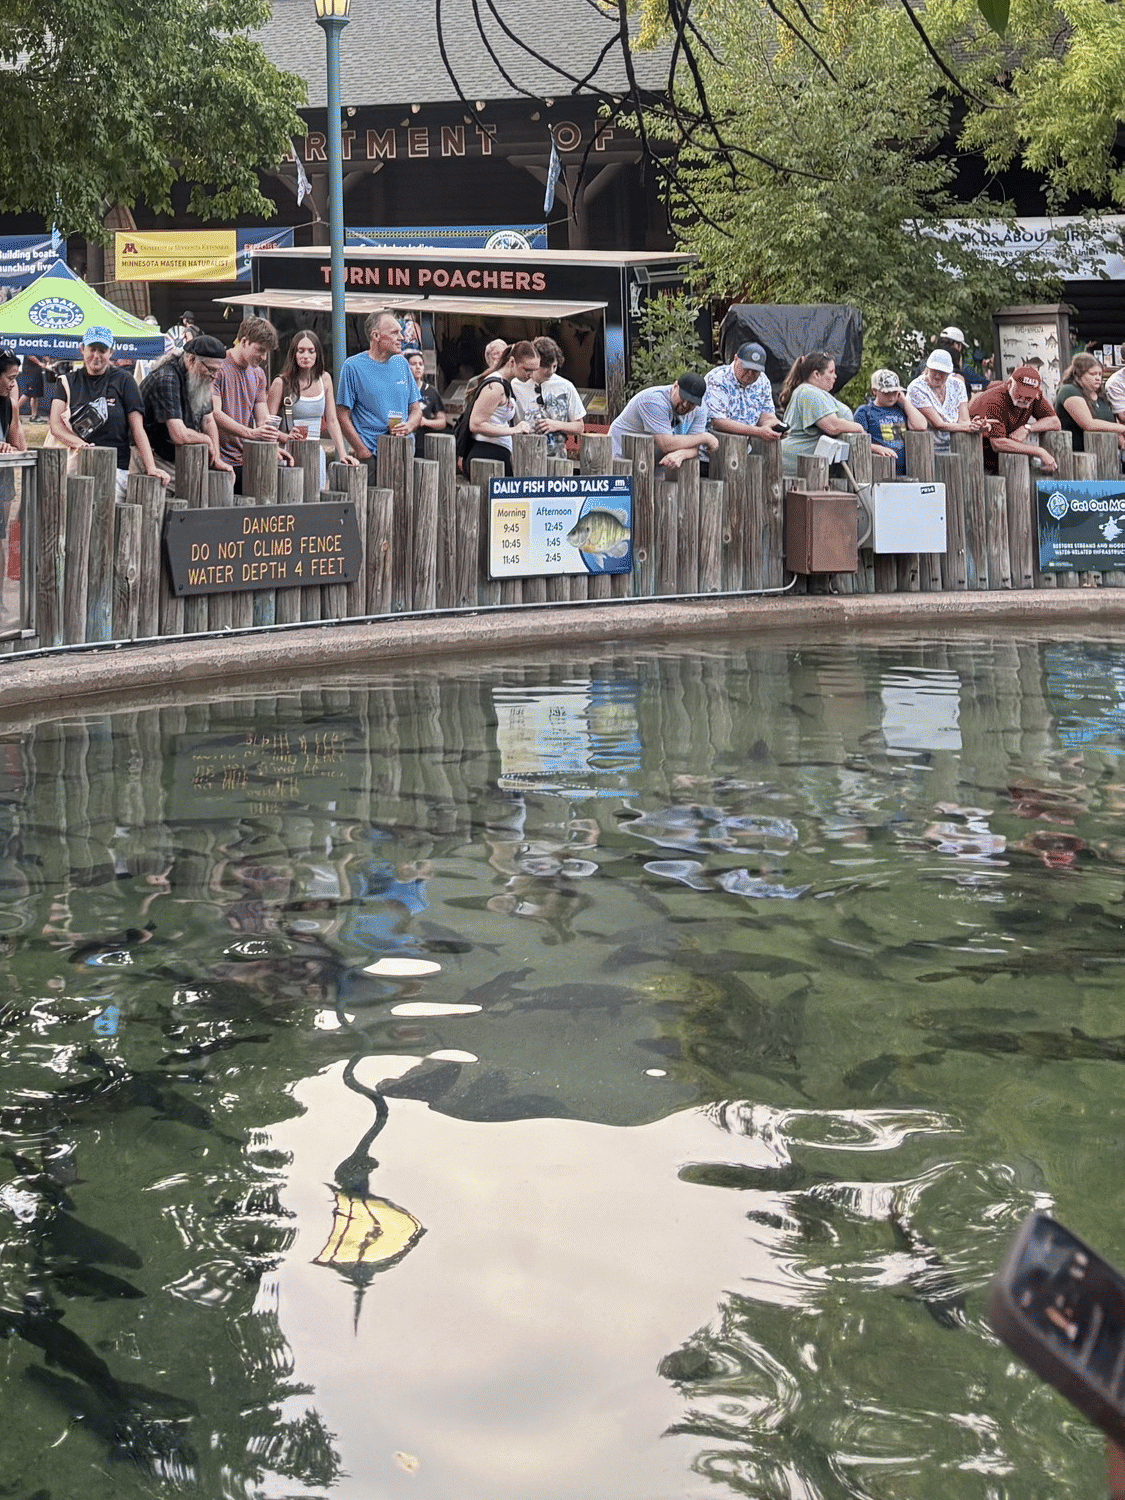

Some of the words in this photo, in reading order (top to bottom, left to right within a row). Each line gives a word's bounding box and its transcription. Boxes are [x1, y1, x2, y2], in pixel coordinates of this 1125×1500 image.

[282, 124, 497, 162] RTMENT
[551, 119, 617, 152] OF
[981, 232, 999, 243] US
[1003, 231, 1048, 243] ABOU
[32, 249, 59, 258] boats.
[37, 262, 53, 271] live
[321, 266, 380, 285] TRN
[387, 267, 410, 286] IN
[418, 269, 547, 291] POACHERS
[37, 298, 76, 309] URBAN
[18, 337, 52, 348] boats.
[111, 341, 138, 351] ives.
[493, 481, 521, 494] DAILY
[522, 480, 545, 493] FISH
[547, 479, 578, 493] POND
[579, 479, 609, 492] TALKS
[1070, 499, 1088, 512] Get
[1089, 499, 1108, 512] Out
[497, 508, 526, 519] Morning
[536, 507, 572, 516] Afternoon
[242, 514, 296, 535] DANGER
[503, 523, 520, 533] 9:45
[544, 522, 563, 531] 12:45
[501, 539, 521, 548] 10:45
[546, 537, 561, 547] 1:45
[190, 543, 211, 562] DO
[218, 540, 245, 560] NOT
[253, 537, 293, 557] CLIMB
[300, 534, 342, 554] FENCE
[503, 555, 520, 564] 11:45
[545, 553, 561, 562] 2:45
[188, 565, 234, 586] WATER
[242, 561, 287, 582] DEPTH
[294, 560, 303, 577] 4
[311, 557, 345, 576] FEET
